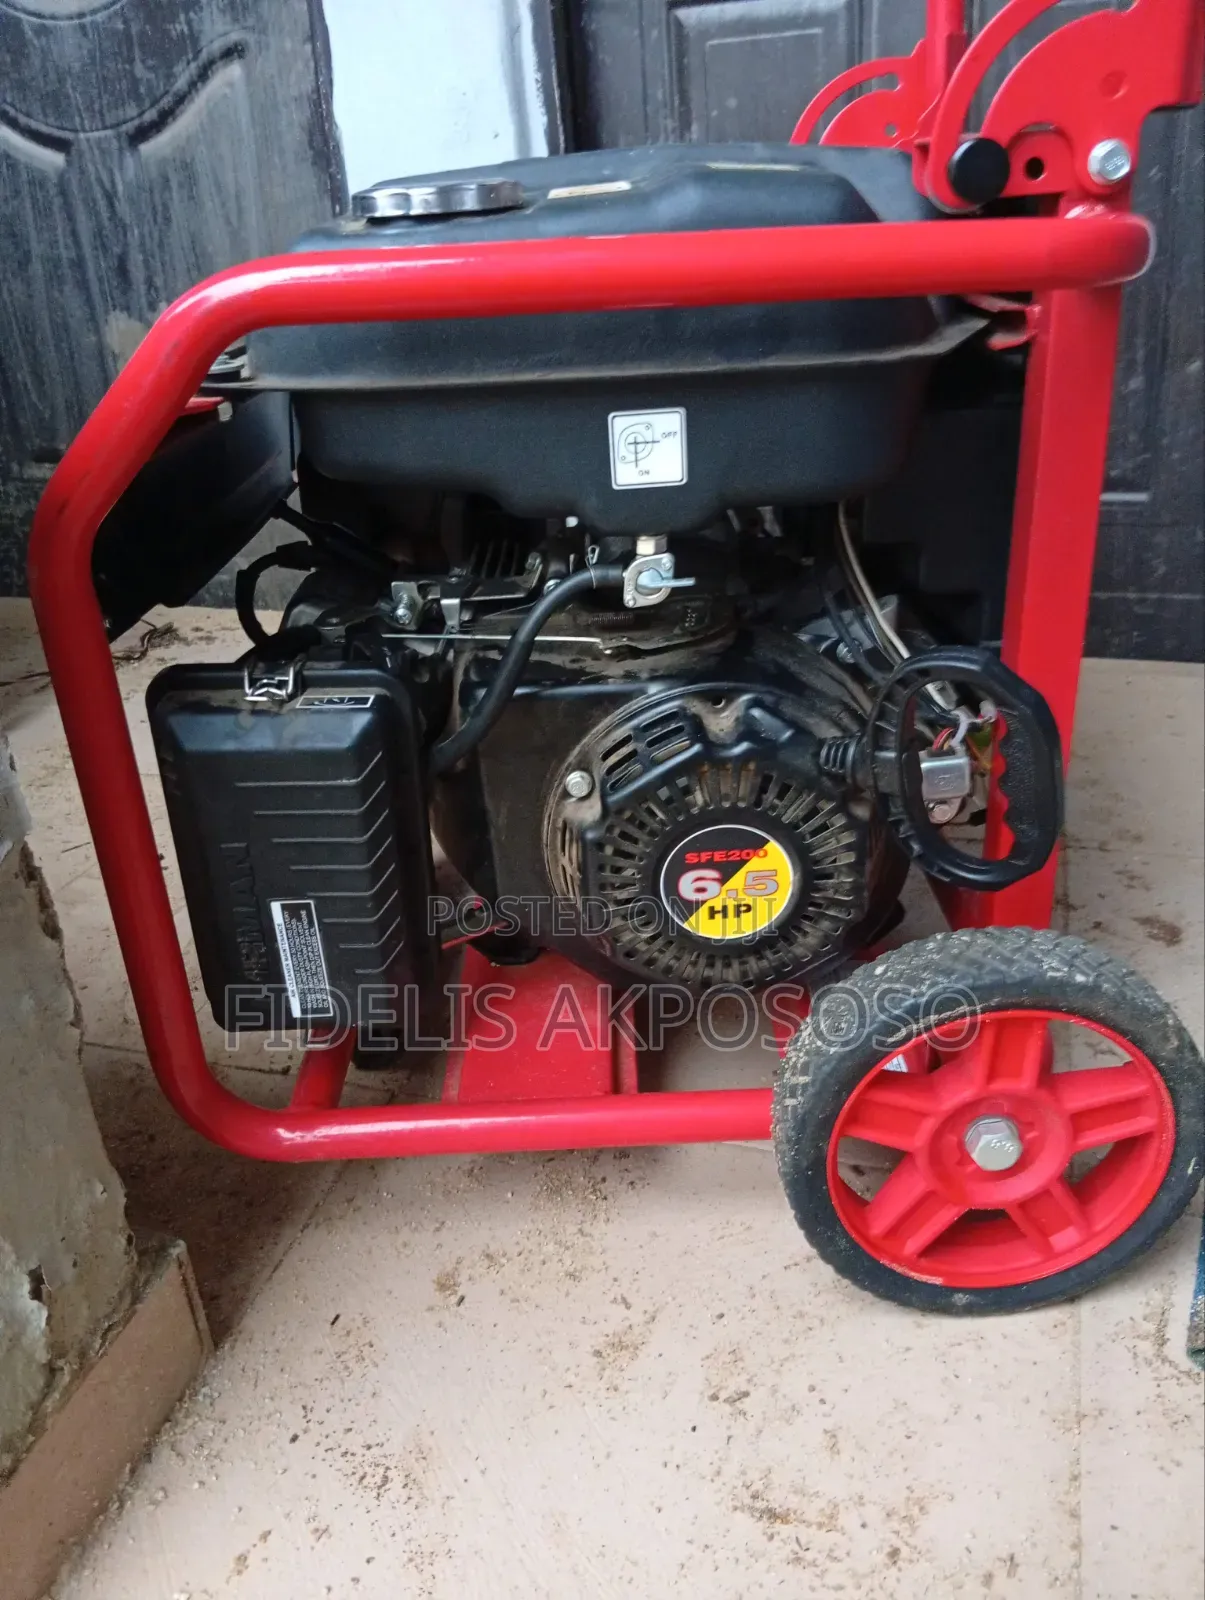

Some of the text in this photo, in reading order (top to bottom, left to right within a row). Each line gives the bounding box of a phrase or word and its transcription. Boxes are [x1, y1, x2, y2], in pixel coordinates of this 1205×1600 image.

[661, 431, 678, 439] OFF
[685, 848, 768, 864] SFE200
[677, 868, 779, 902] 6.5
[708, 903, 752, 920] HP
[276, 923, 289, 961] MAINTENANCE
[284, 963, 294, 987] CLEANER
